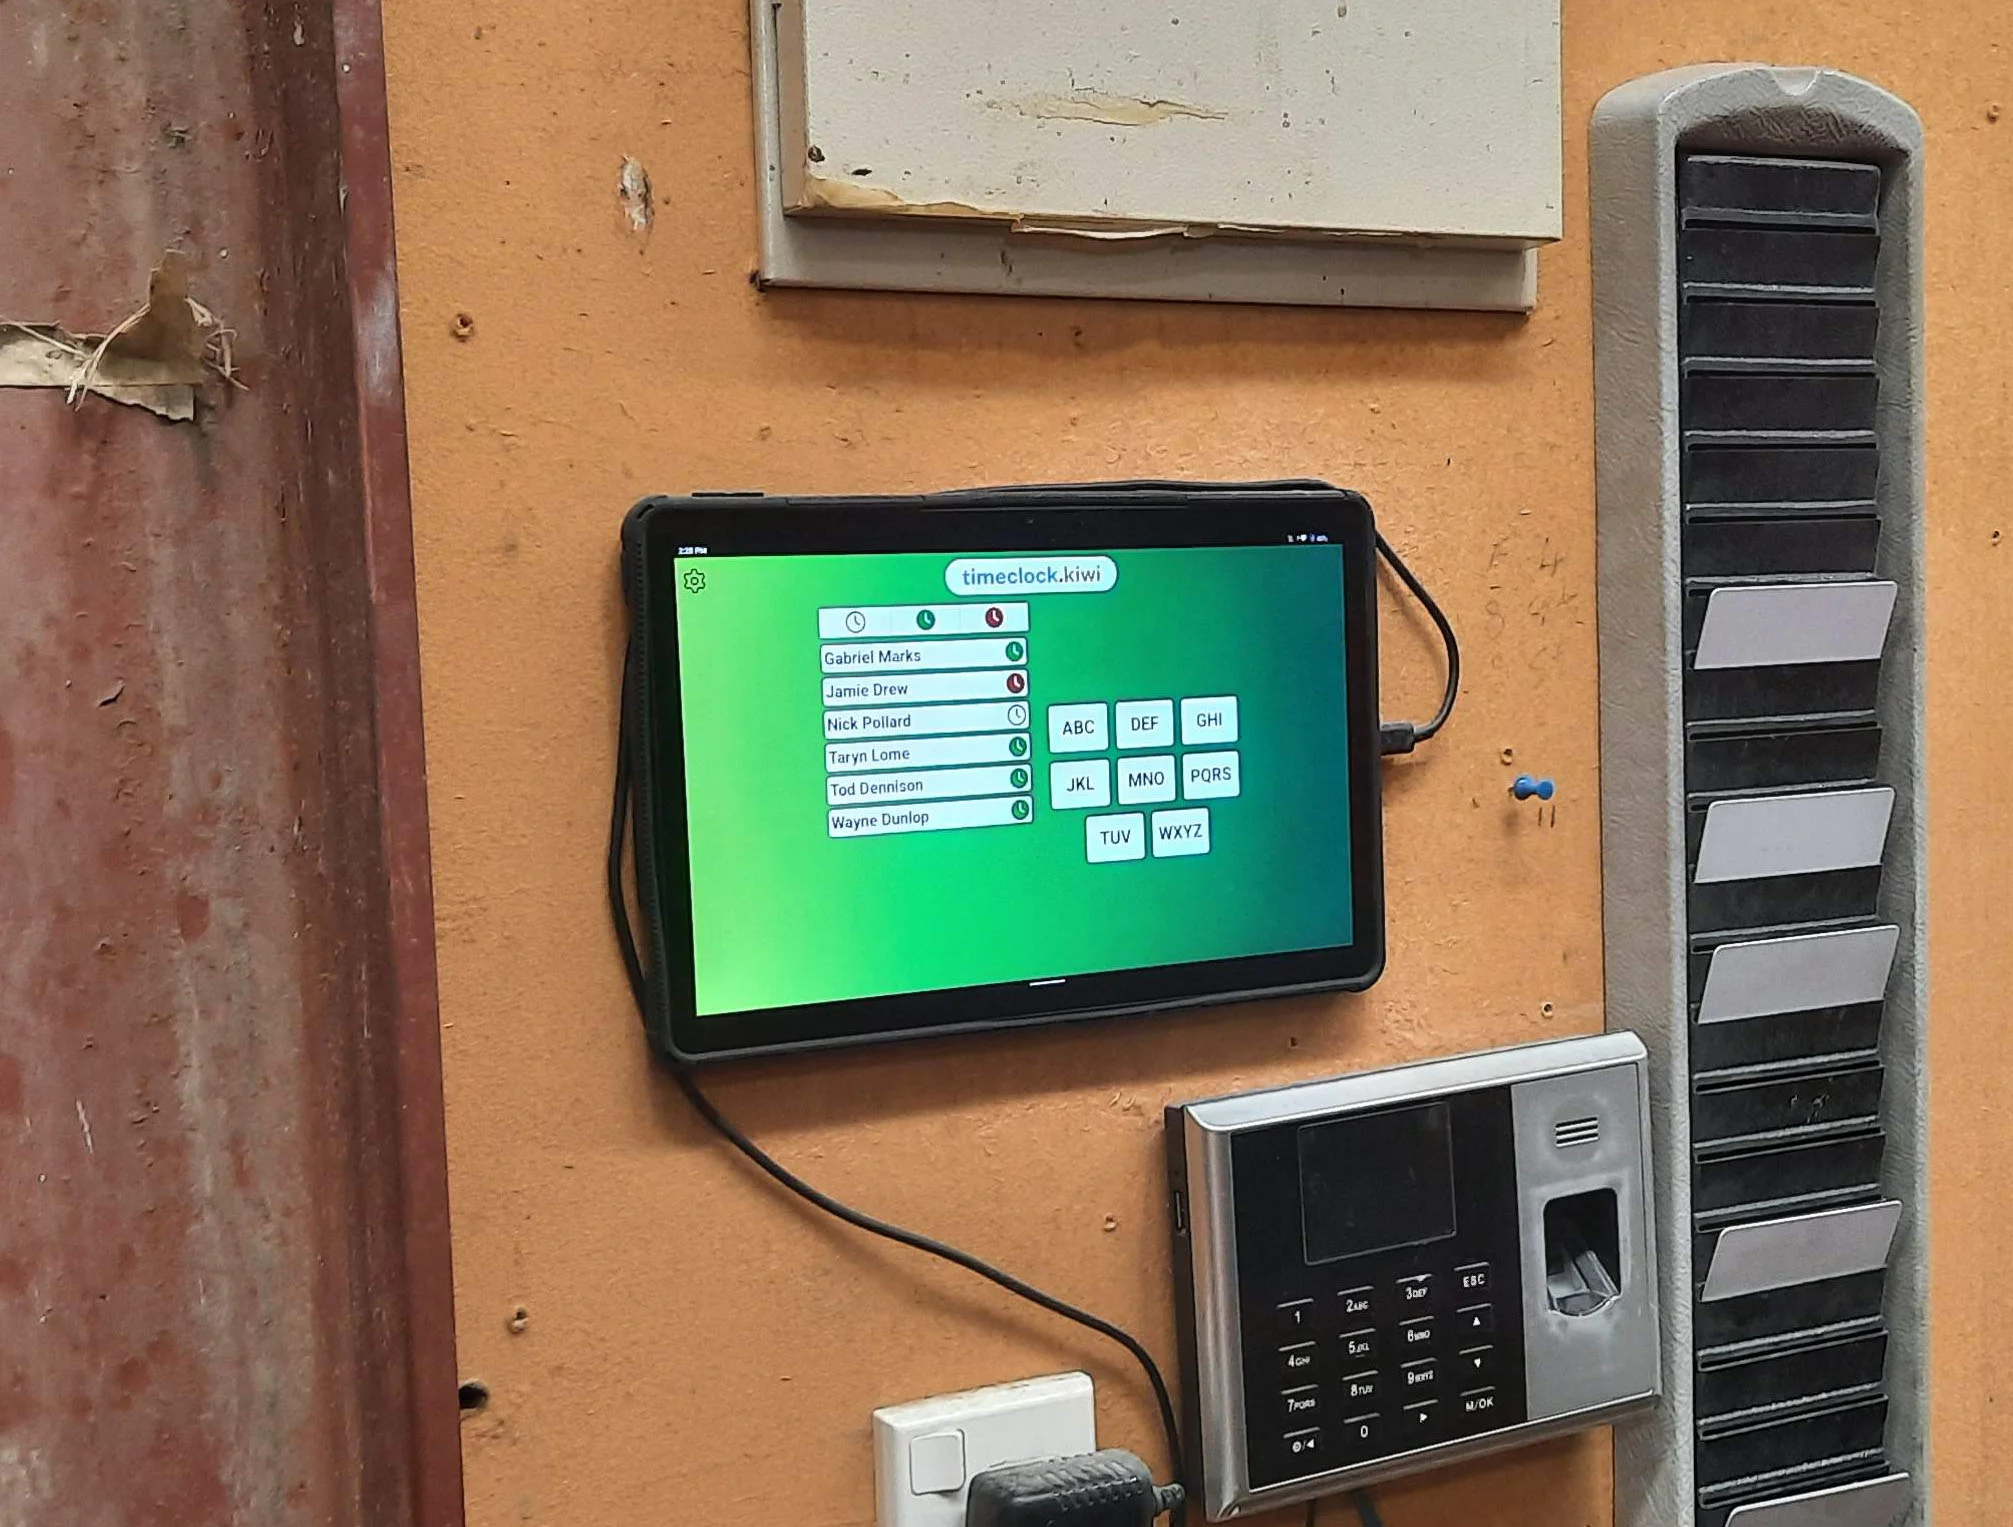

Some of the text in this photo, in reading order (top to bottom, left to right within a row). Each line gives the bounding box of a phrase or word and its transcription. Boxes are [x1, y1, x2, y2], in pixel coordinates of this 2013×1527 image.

[962, 565, 1101, 586] timeclock.kiwi
[824, 649, 921, 666] Gabriel Marks
[826, 682, 908, 699] Jamie Drew
[827, 714, 912, 732] Nick Pollard
[1062, 719, 1095, 735] ABC
[1131, 715, 1159, 731] DEF
[1196, 712, 1223, 729] GHI
[828, 749, 868, 766] Taryn
[1128, 771, 1165, 787] MNO
[1190, 766, 1232, 783] PQRS
[830, 779, 924, 797] Tod Dennison
[1066, 776, 1095, 793] JKL
[831, 811, 930, 831] Wayne Dunlop
[1100, 829, 1131, 845] TUV
[1159, 824, 1203, 841] WXYZ
[1294, 1310, 1301, 1324] 1
